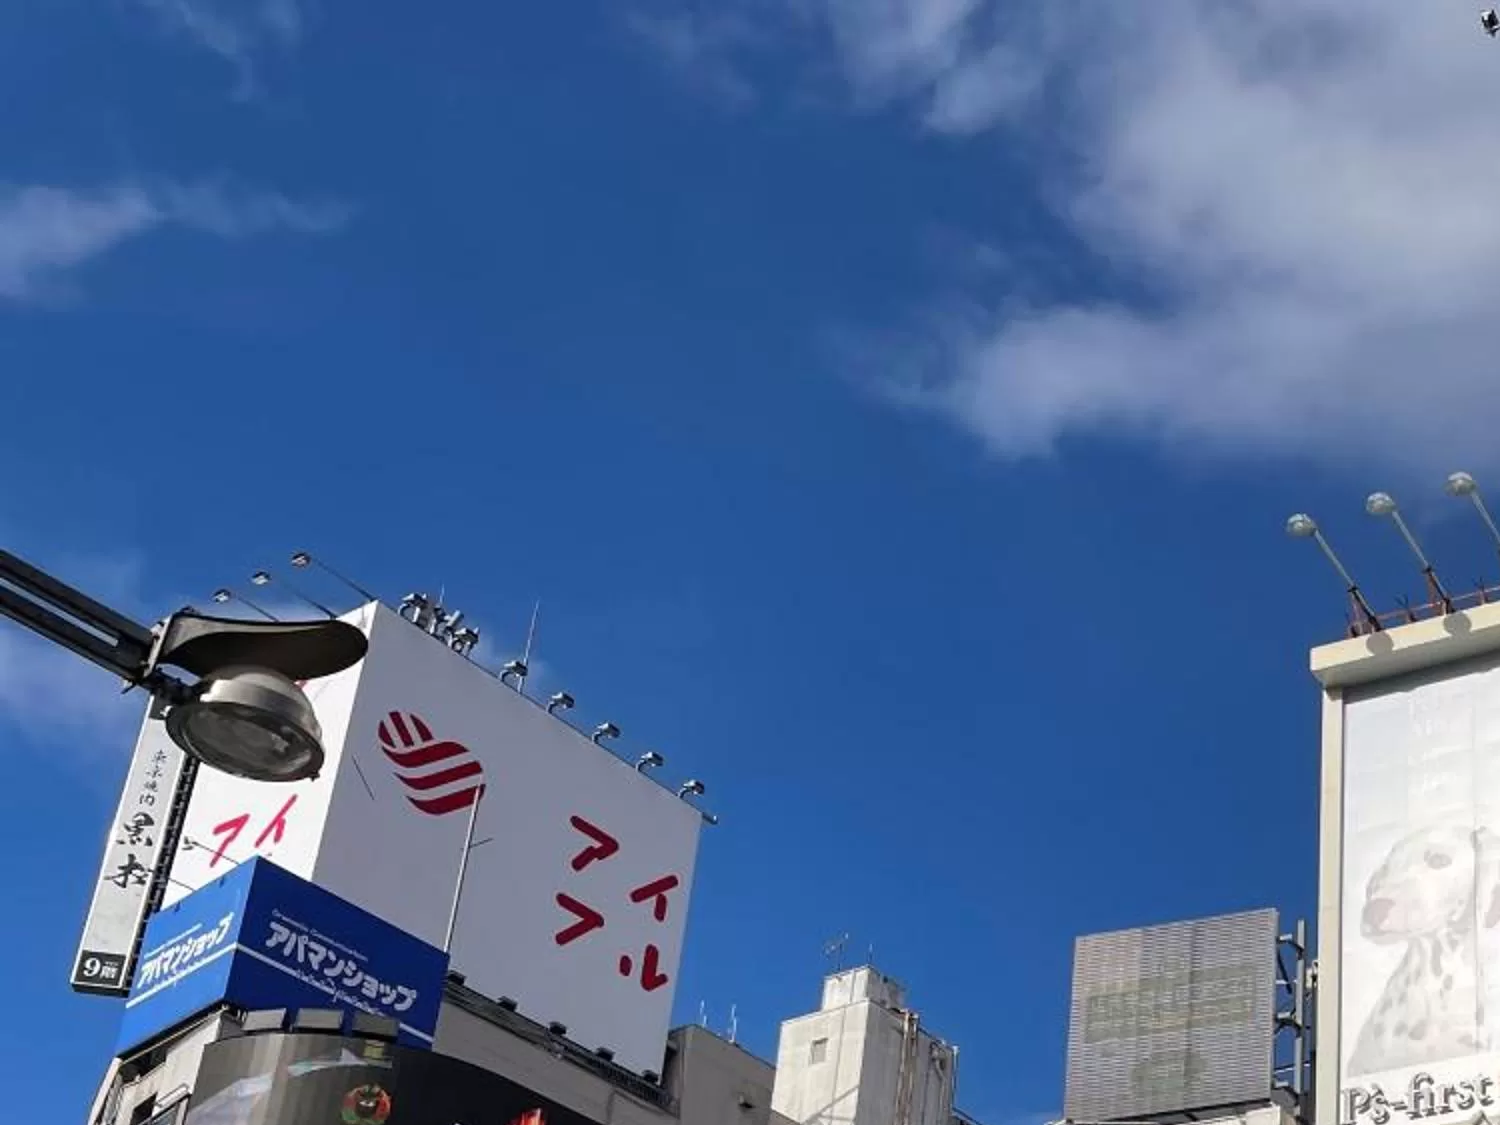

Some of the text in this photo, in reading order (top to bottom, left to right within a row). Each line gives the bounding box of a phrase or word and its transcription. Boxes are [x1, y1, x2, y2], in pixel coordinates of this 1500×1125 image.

[137, 911, 235, 989] アパマンショップ
[265, 920, 418, 1012] アパマンショップ
